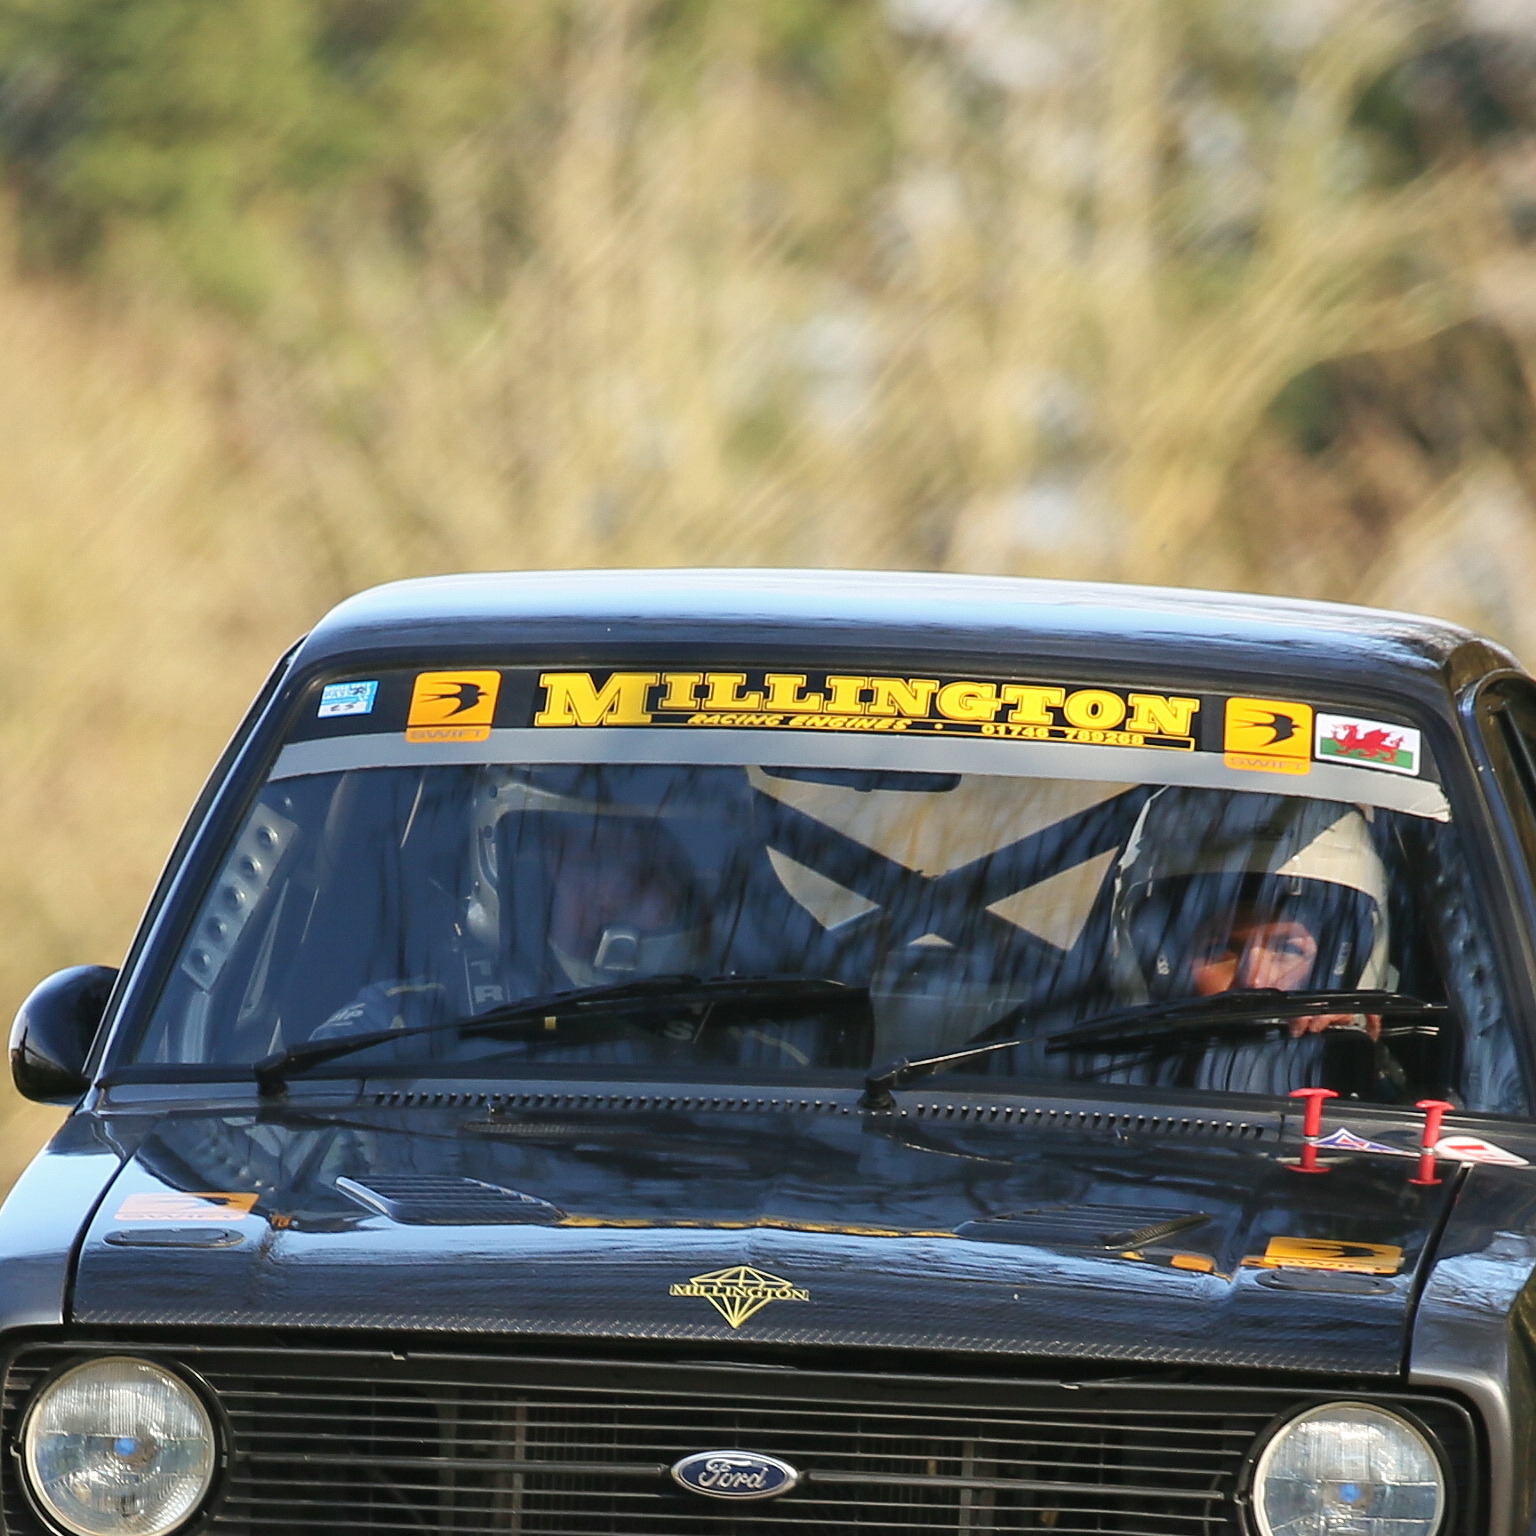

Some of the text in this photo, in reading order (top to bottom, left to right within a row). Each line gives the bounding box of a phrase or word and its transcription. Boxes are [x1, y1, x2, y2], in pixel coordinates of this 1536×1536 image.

[534, 671, 1200, 736] MILLINGTON
[687, 714, 784, 726] RACING
[789, 716, 912, 731] ENGINES
[1231, 757, 1304, 771] SWIFT
[669, 1284, 810, 1302] MILLINGTON
[697, 1458, 769, 1490] Ford
